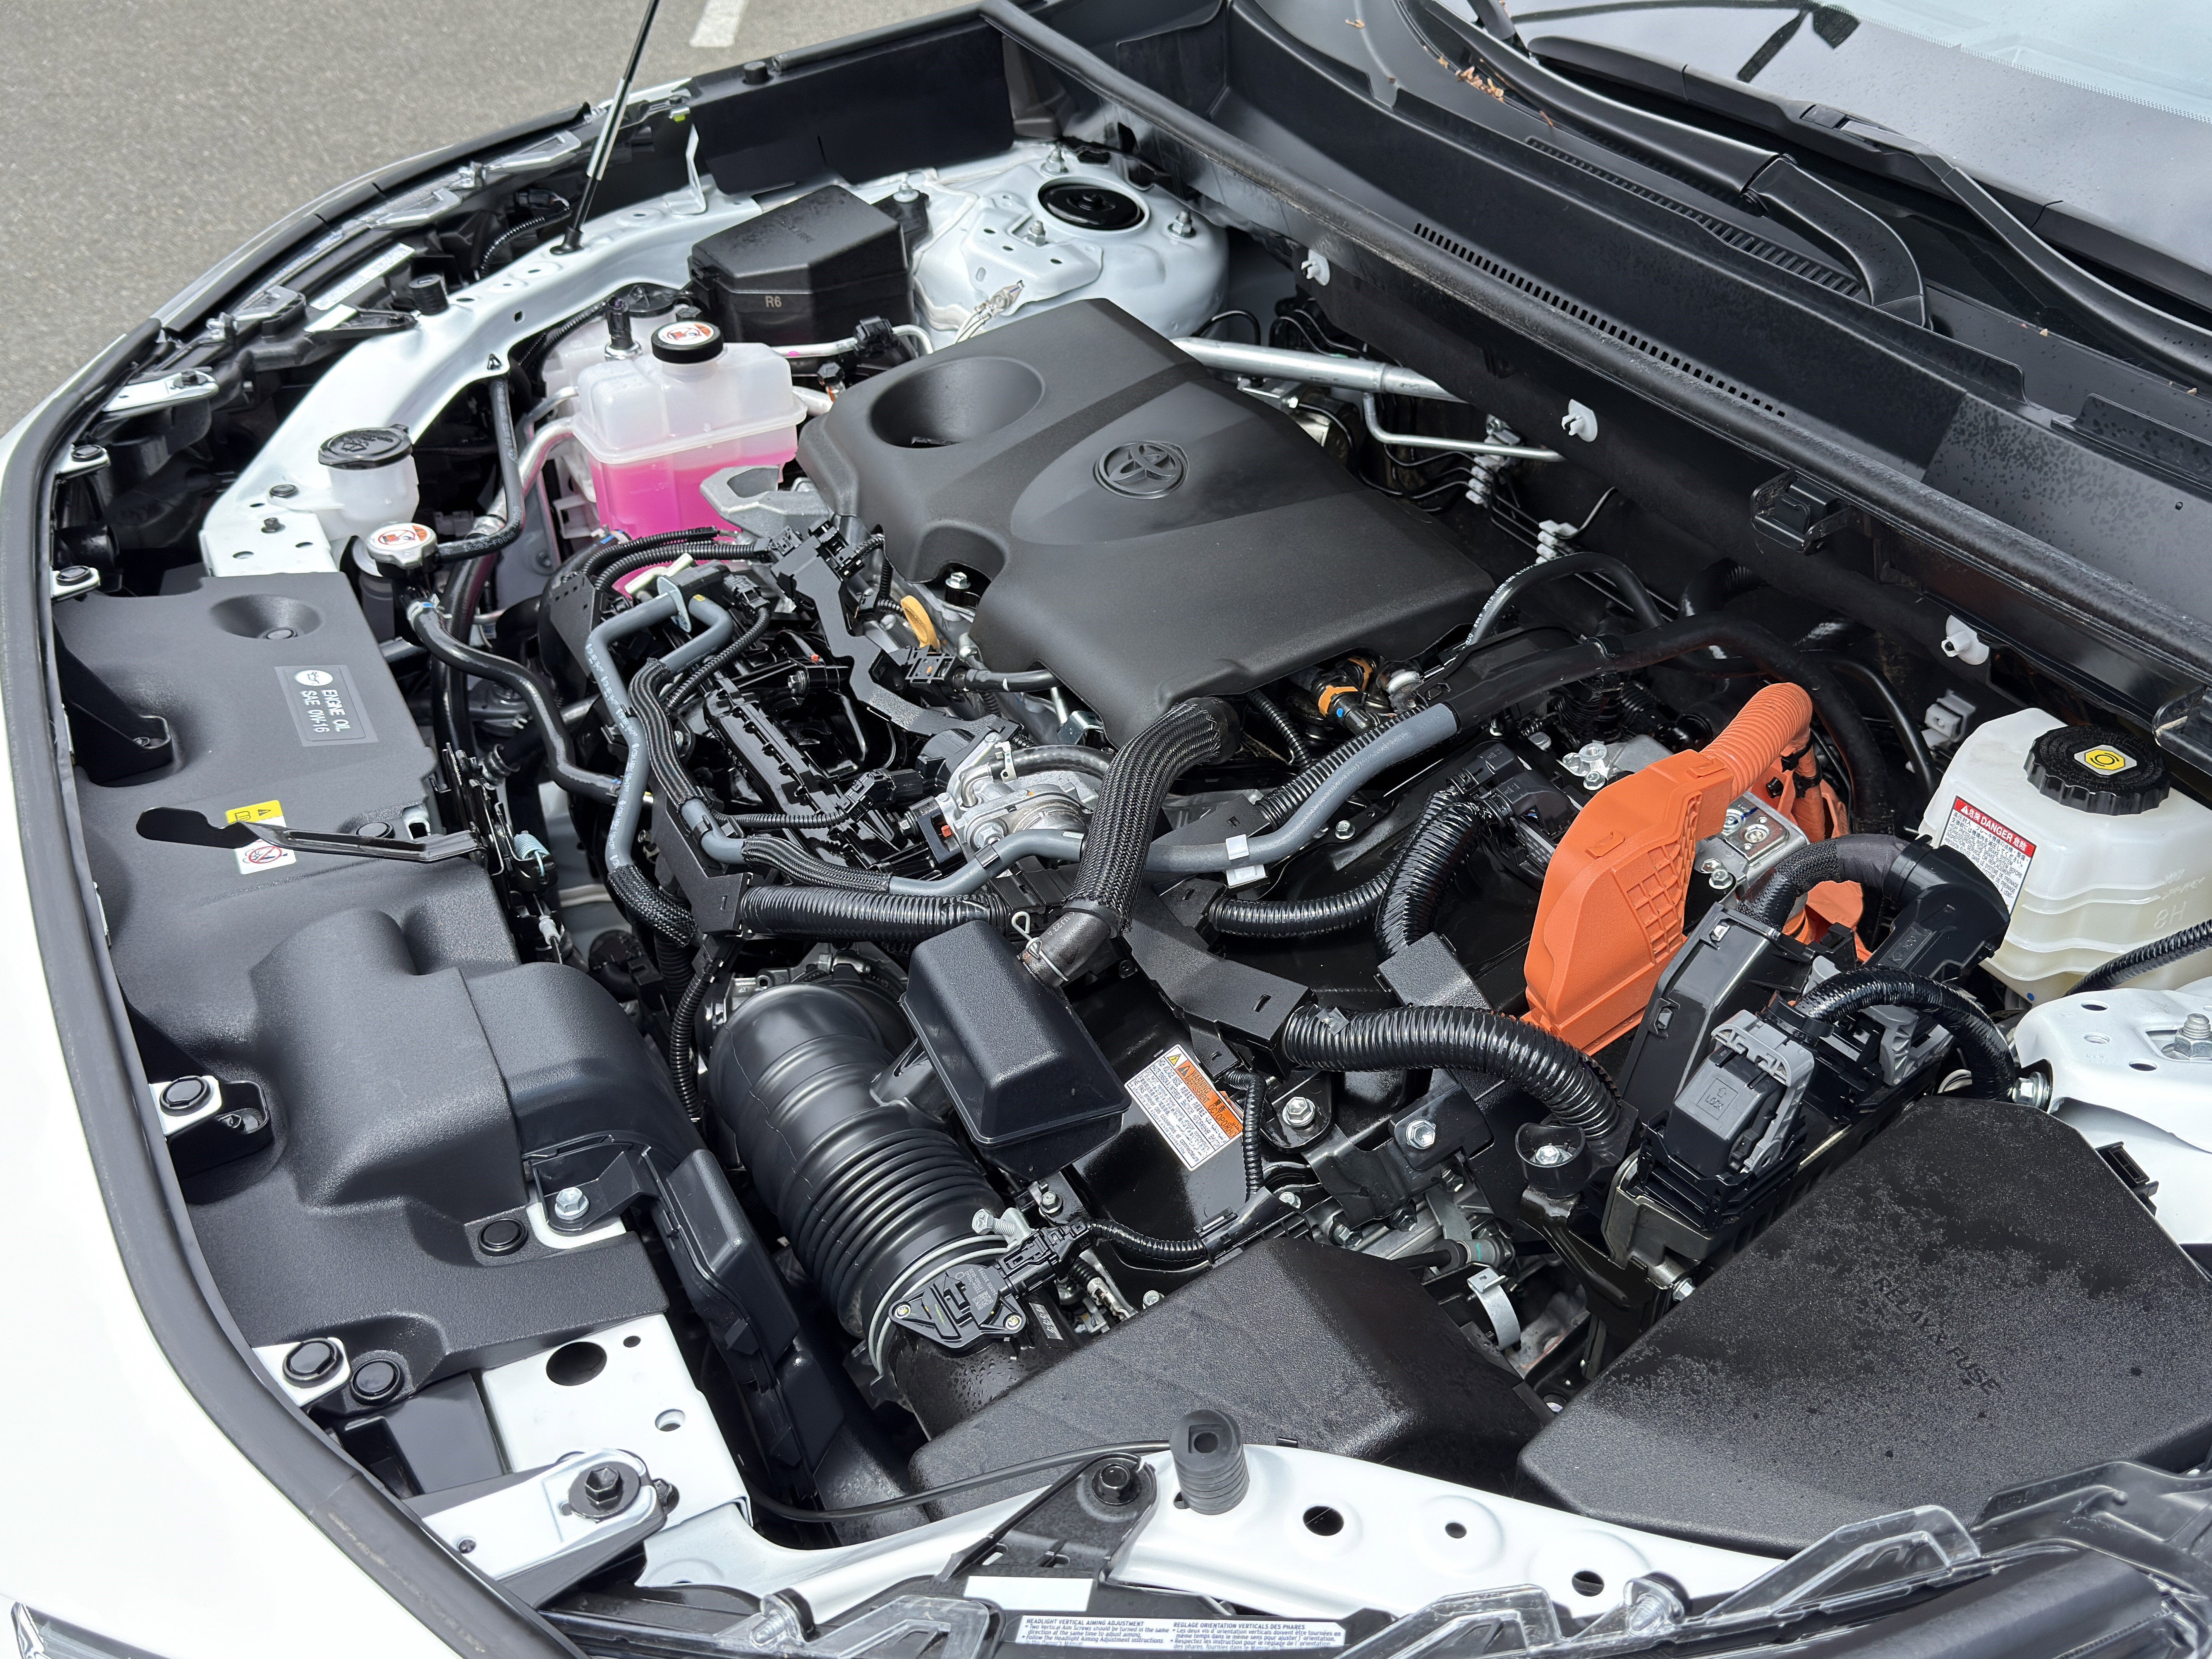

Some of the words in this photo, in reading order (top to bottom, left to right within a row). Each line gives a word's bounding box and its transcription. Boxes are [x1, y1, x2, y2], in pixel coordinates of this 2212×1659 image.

[765, 295, 782, 307] R6
[300, 690, 321, 706] SAE
[321, 689, 346, 716] ENGINE
[307, 709, 330, 733] 0W-16
[332, 719, 350, 732] OIL
[1980, 816, 2013, 842] DANGER
[1958, 828, 1975, 842] PRESSURE
[1976, 839, 1987, 849] INSIDE
[1987, 847, 1999, 857] BRAKE
[1999, 854, 2013, 866] SYSTEM
[1944, 837, 1959, 850] PRESSION
[1971, 854, 1980, 863] DANS
[2003, 876, 2019, 889] FREINAGE
[1984, 850, 1995, 860] BRAKE
[1995, 857, 2009, 869] SYSTEM
[2009, 866, 2022, 878] BEFORE
[2000, 880, 2016, 893] FREINAGE
[1137, 1084, 1146, 1094] PAS
[1150, 1075, 1159, 1084] NOT
[1183, 1074, 1210, 1104] AVERTISSEMENT
[1190, 1069, 1212, 1094] WARNING
[1705, 1094, 1724, 1110] LOCK
[1207, 1103, 1237, 1138] ОСТОРОЖНО
[955, 1271, 965, 1280] D
[1946, 1346, 2003, 1395] FUSE
